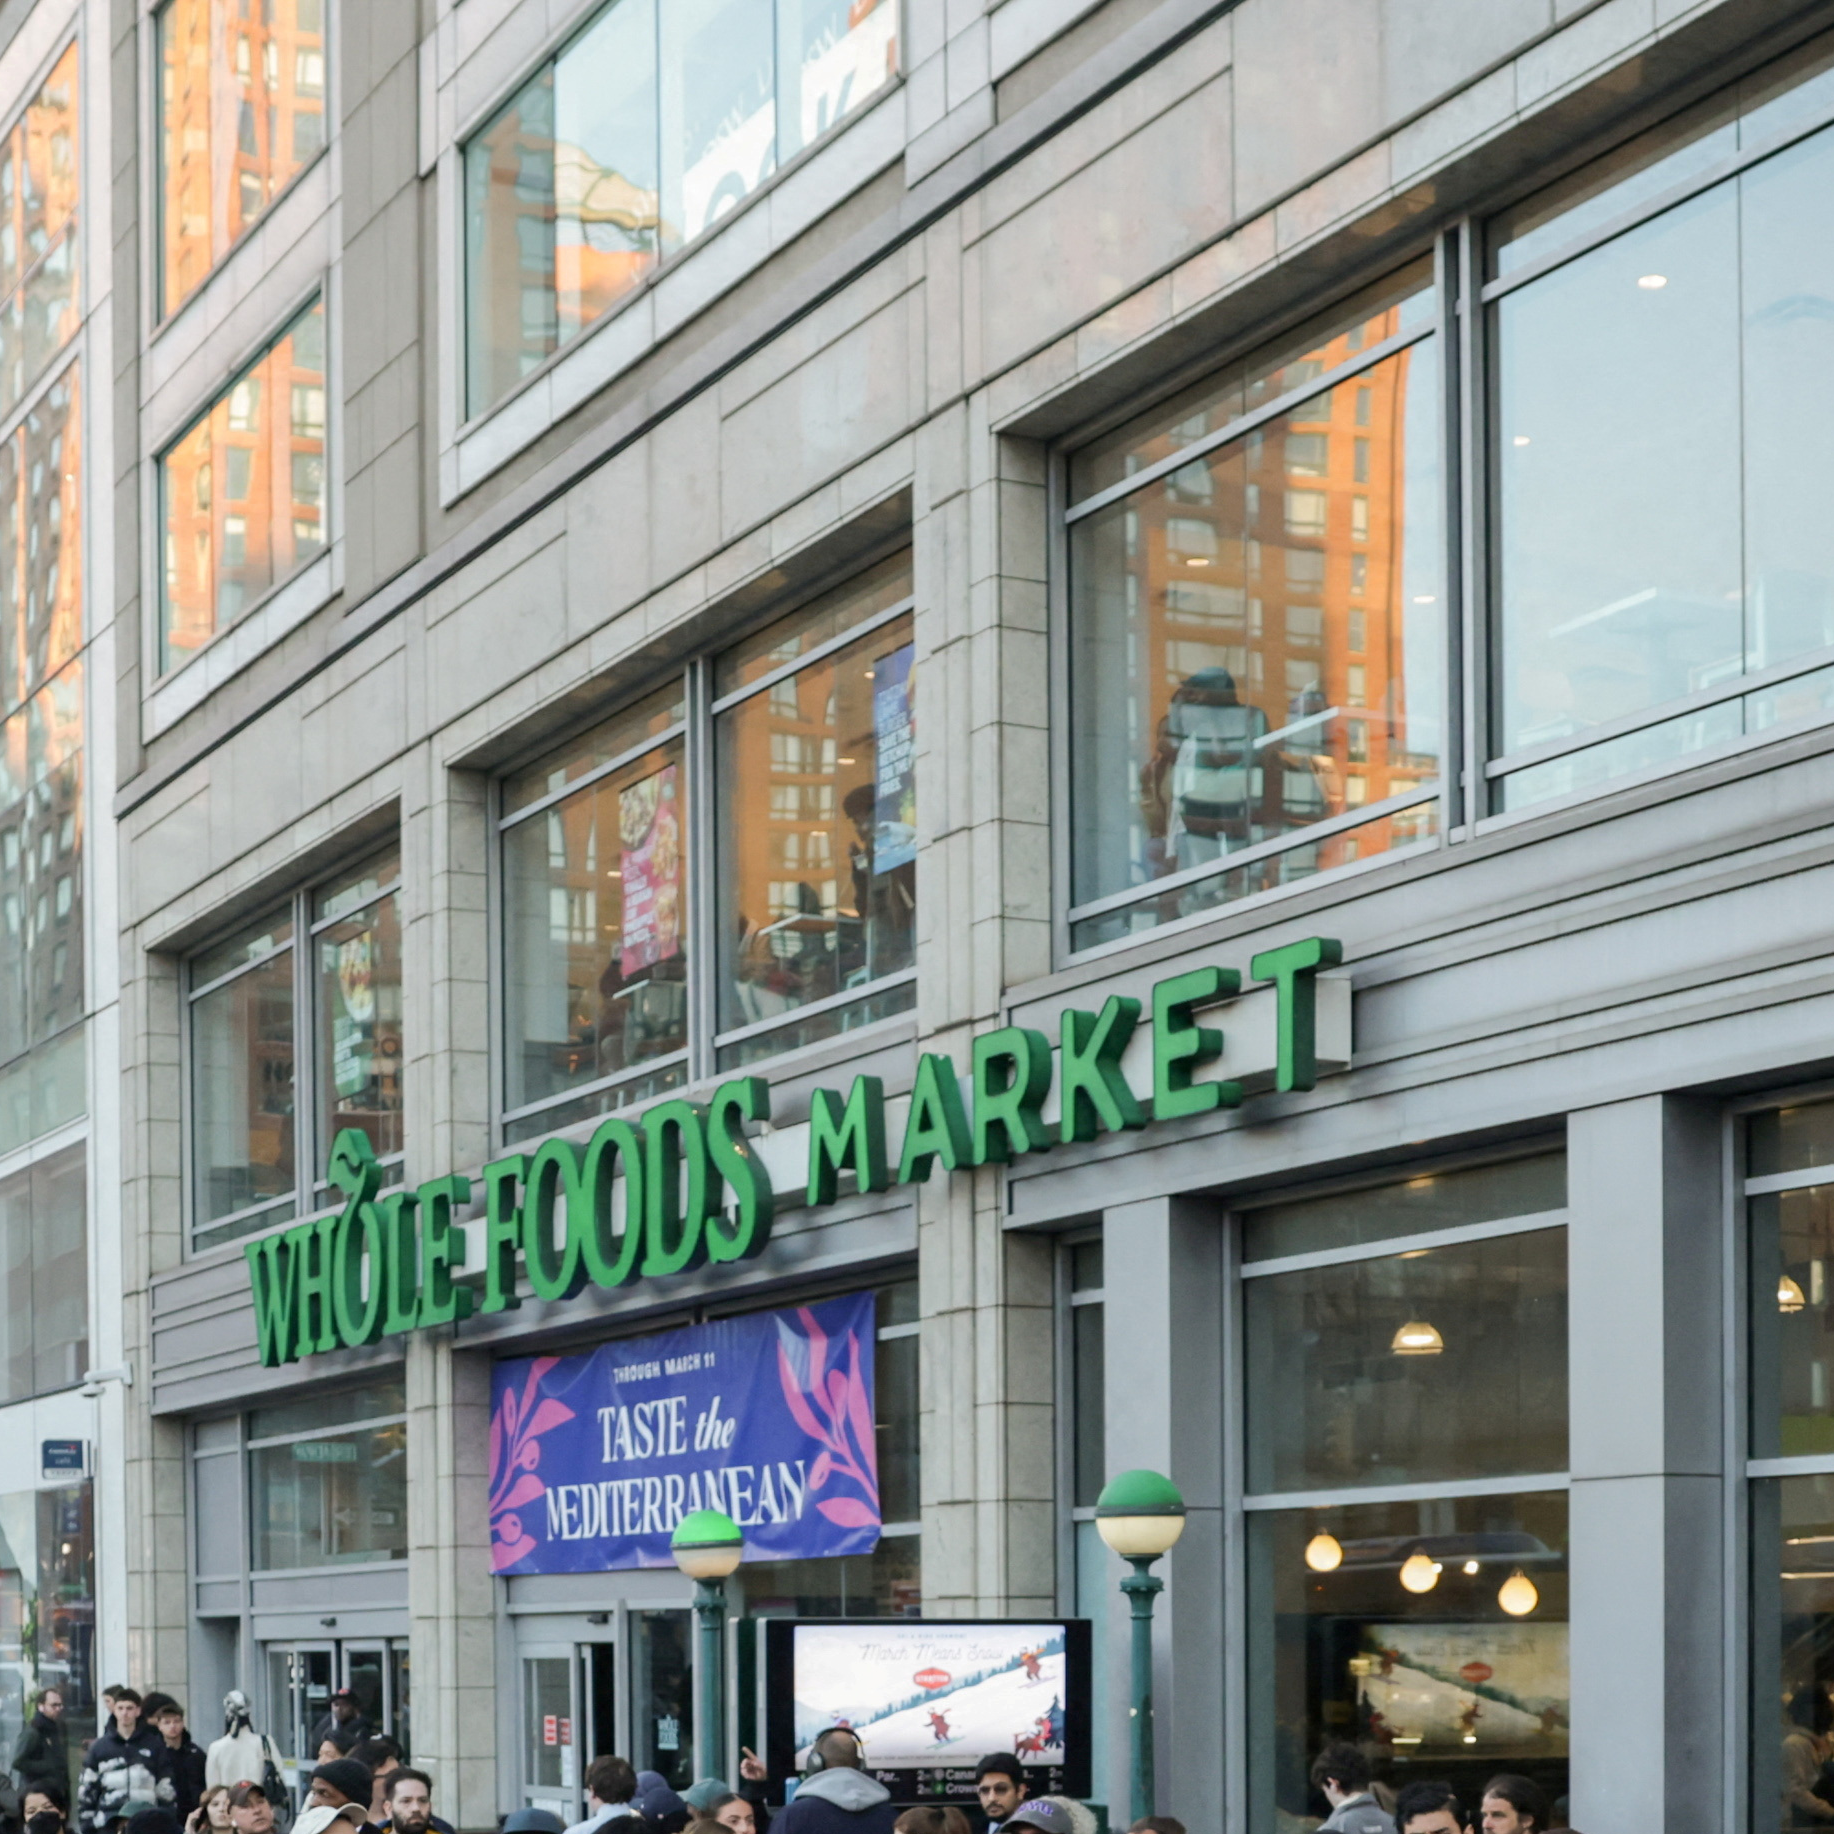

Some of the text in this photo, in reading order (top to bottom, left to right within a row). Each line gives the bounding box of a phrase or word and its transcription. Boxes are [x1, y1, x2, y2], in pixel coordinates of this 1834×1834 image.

[245, 937, 1343, 1368] WHOLE FOODS MARKET
[613, 1351, 716, 1384] THROUGH MARCH 11
[597, 1396, 737, 1464] TASTE the
[546, 1460, 806, 1542] MEDITERRANEAN
[858, 1644, 910, 1661] March
[915, 1643, 963, 1661] Means
